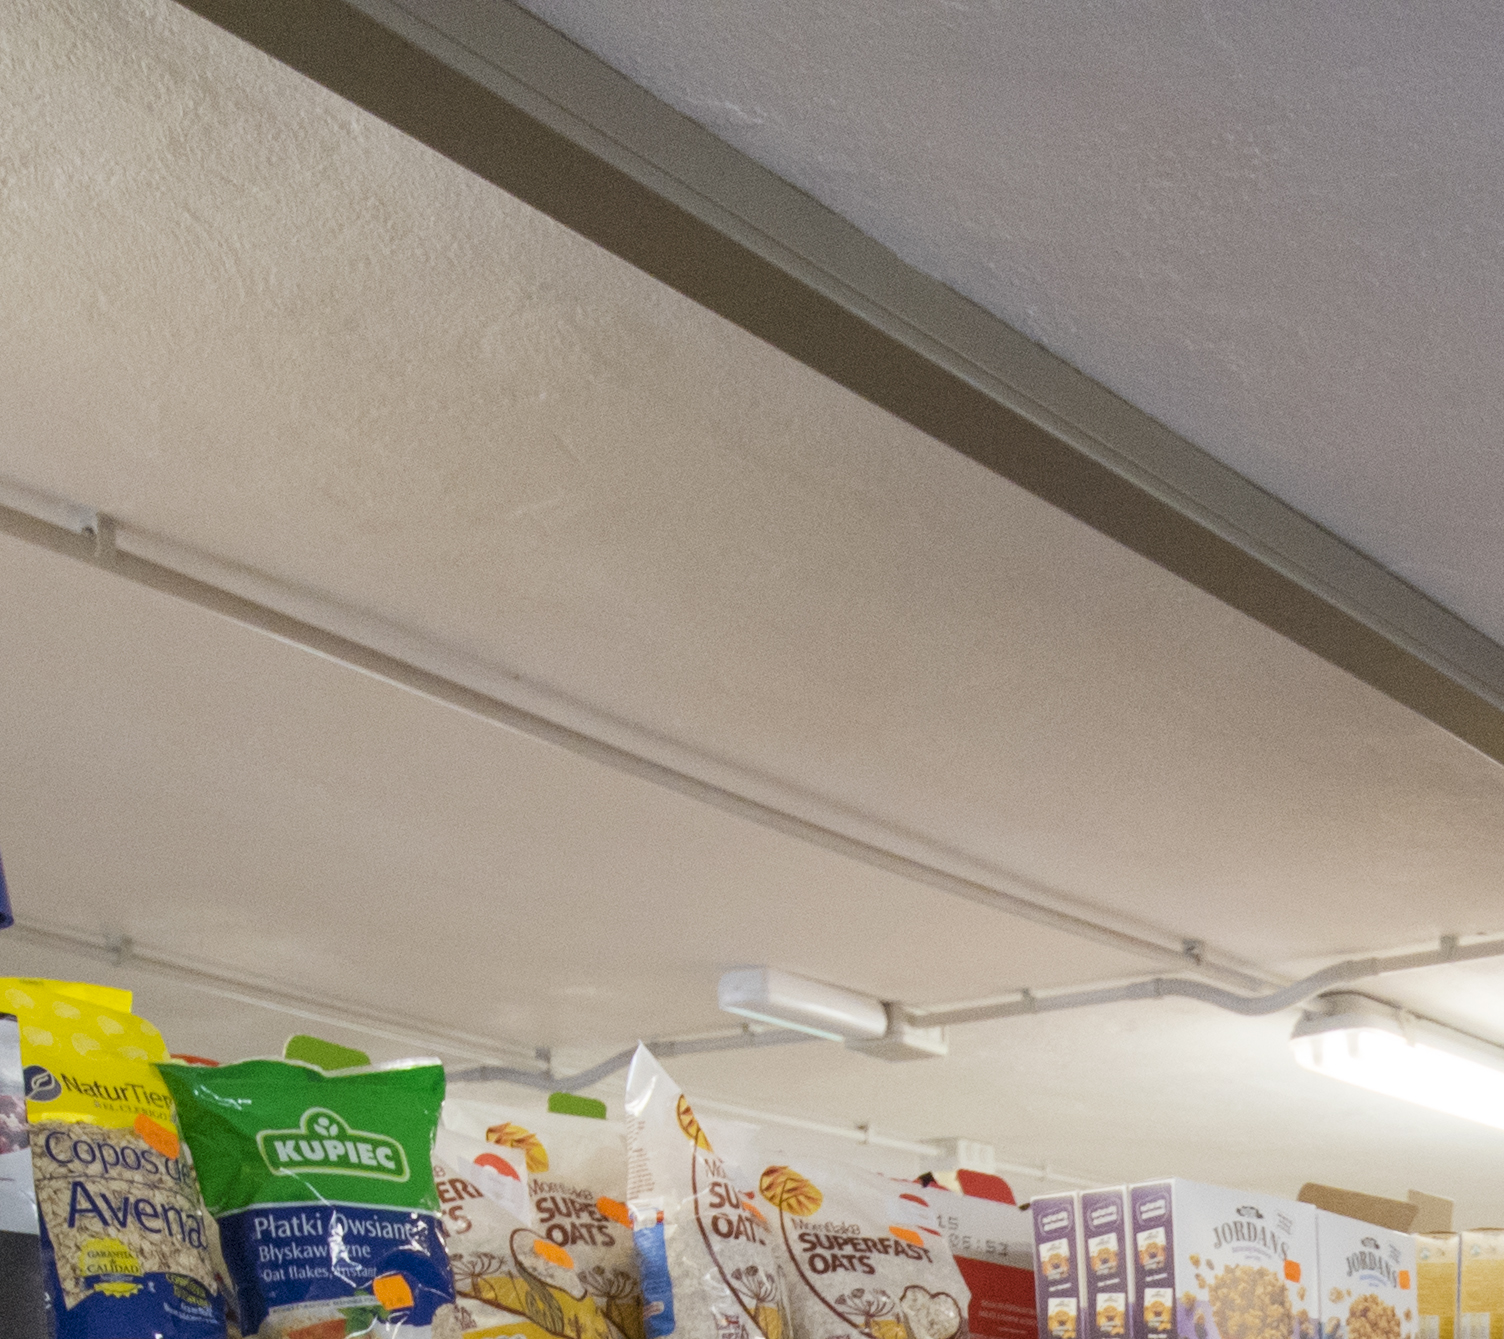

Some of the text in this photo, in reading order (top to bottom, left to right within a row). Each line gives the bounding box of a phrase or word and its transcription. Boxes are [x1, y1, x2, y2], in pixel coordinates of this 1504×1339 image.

[44, 1130, 159, 1174] Copos
[276, 1137, 396, 1170] KUPIEC
[67, 1180, 207, 1250] Avena
[546, 1223, 616, 1247] OATS
[798, 1233, 933, 1263] SUPERFAST
[1213, 1220, 1289, 1261] JORDANS
[808, 1254, 876, 1275] OATS
[1344, 1252, 1399, 1287] JORDANS
